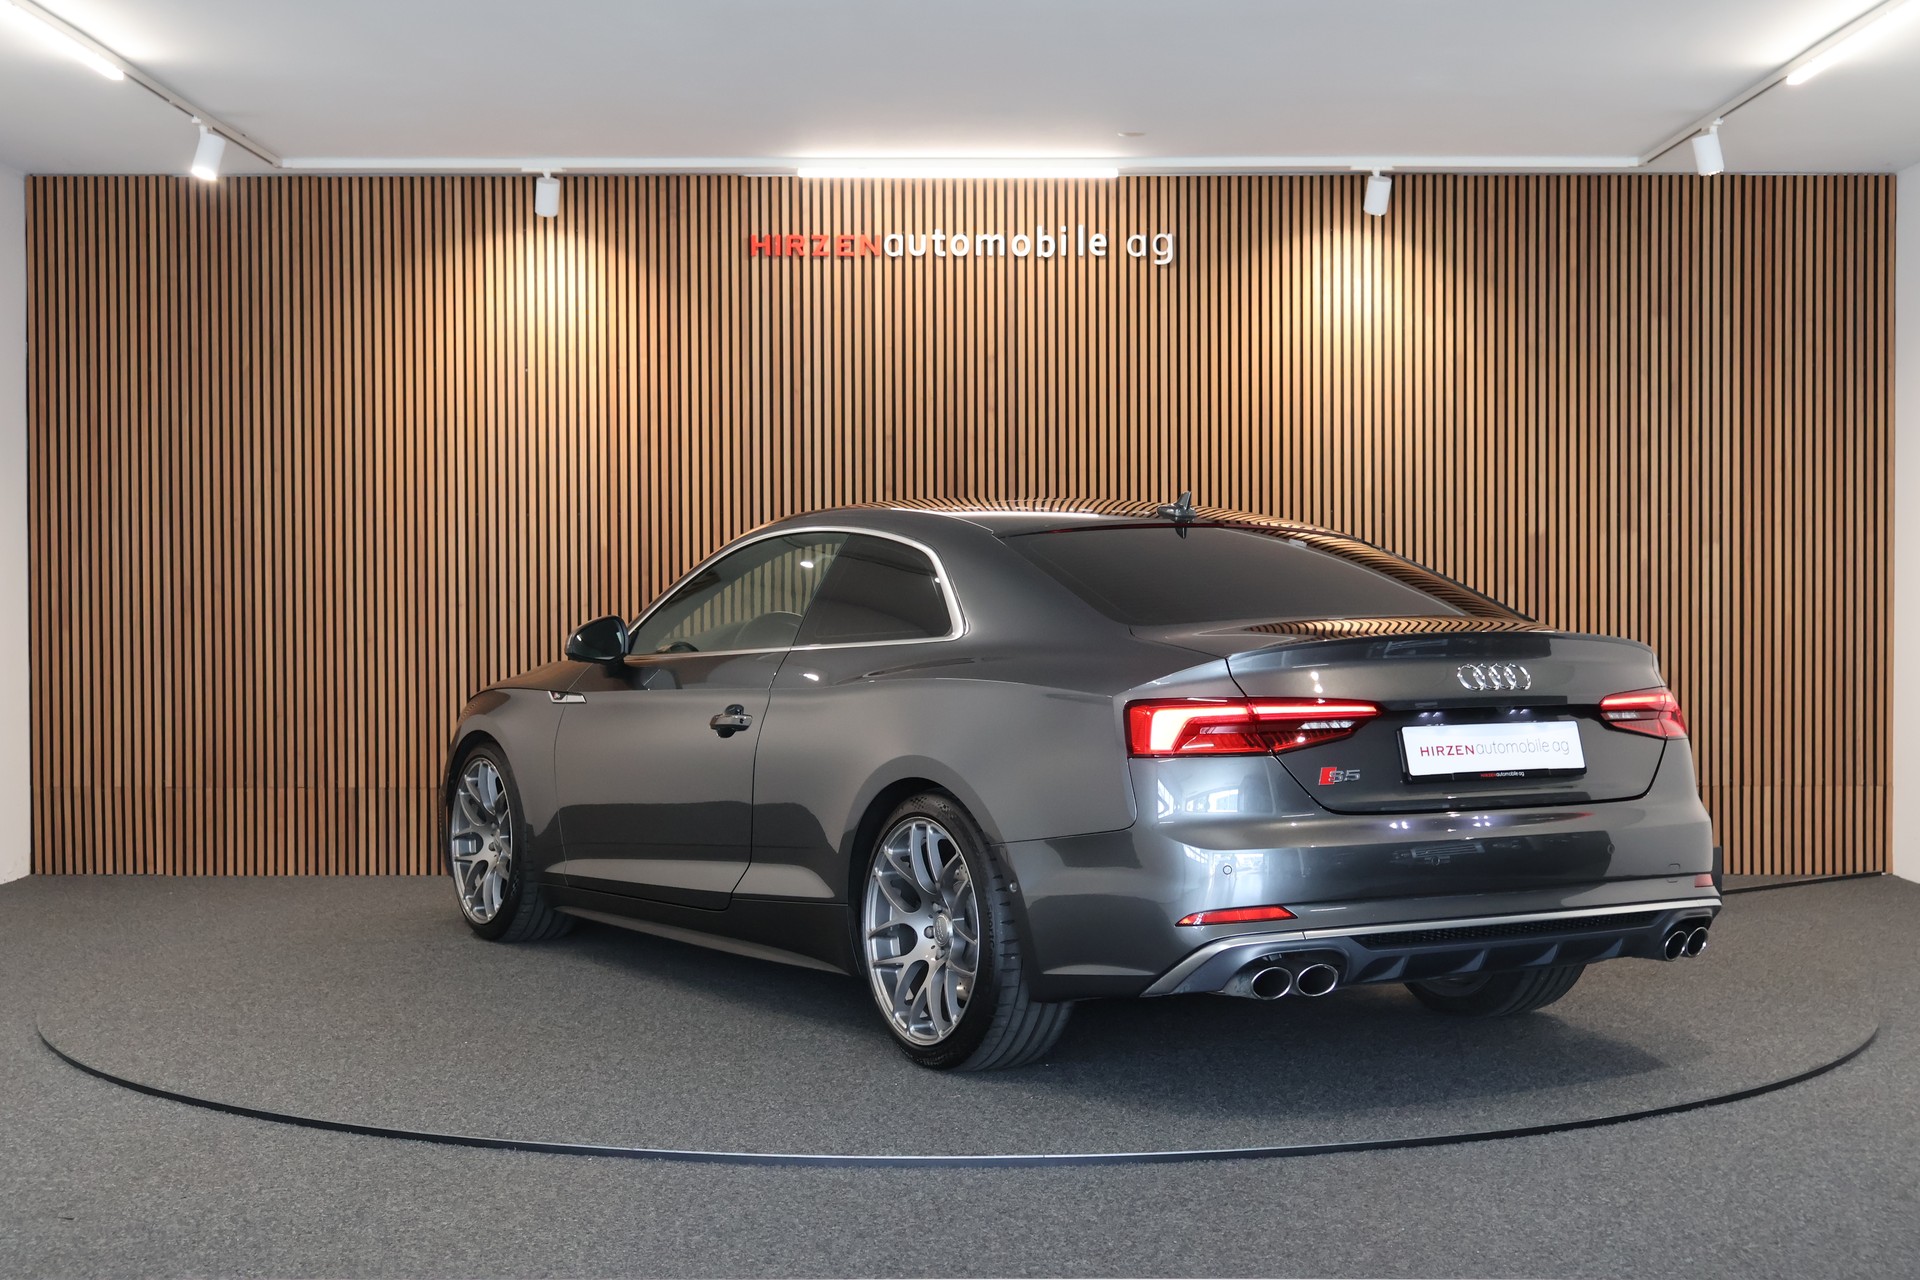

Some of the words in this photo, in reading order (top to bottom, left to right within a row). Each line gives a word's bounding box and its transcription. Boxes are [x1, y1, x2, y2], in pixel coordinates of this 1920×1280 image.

[1127, 233, 1173, 265] ag
[1552, 740, 1569, 755] ag
[1328, 769, 1360, 782] S5
